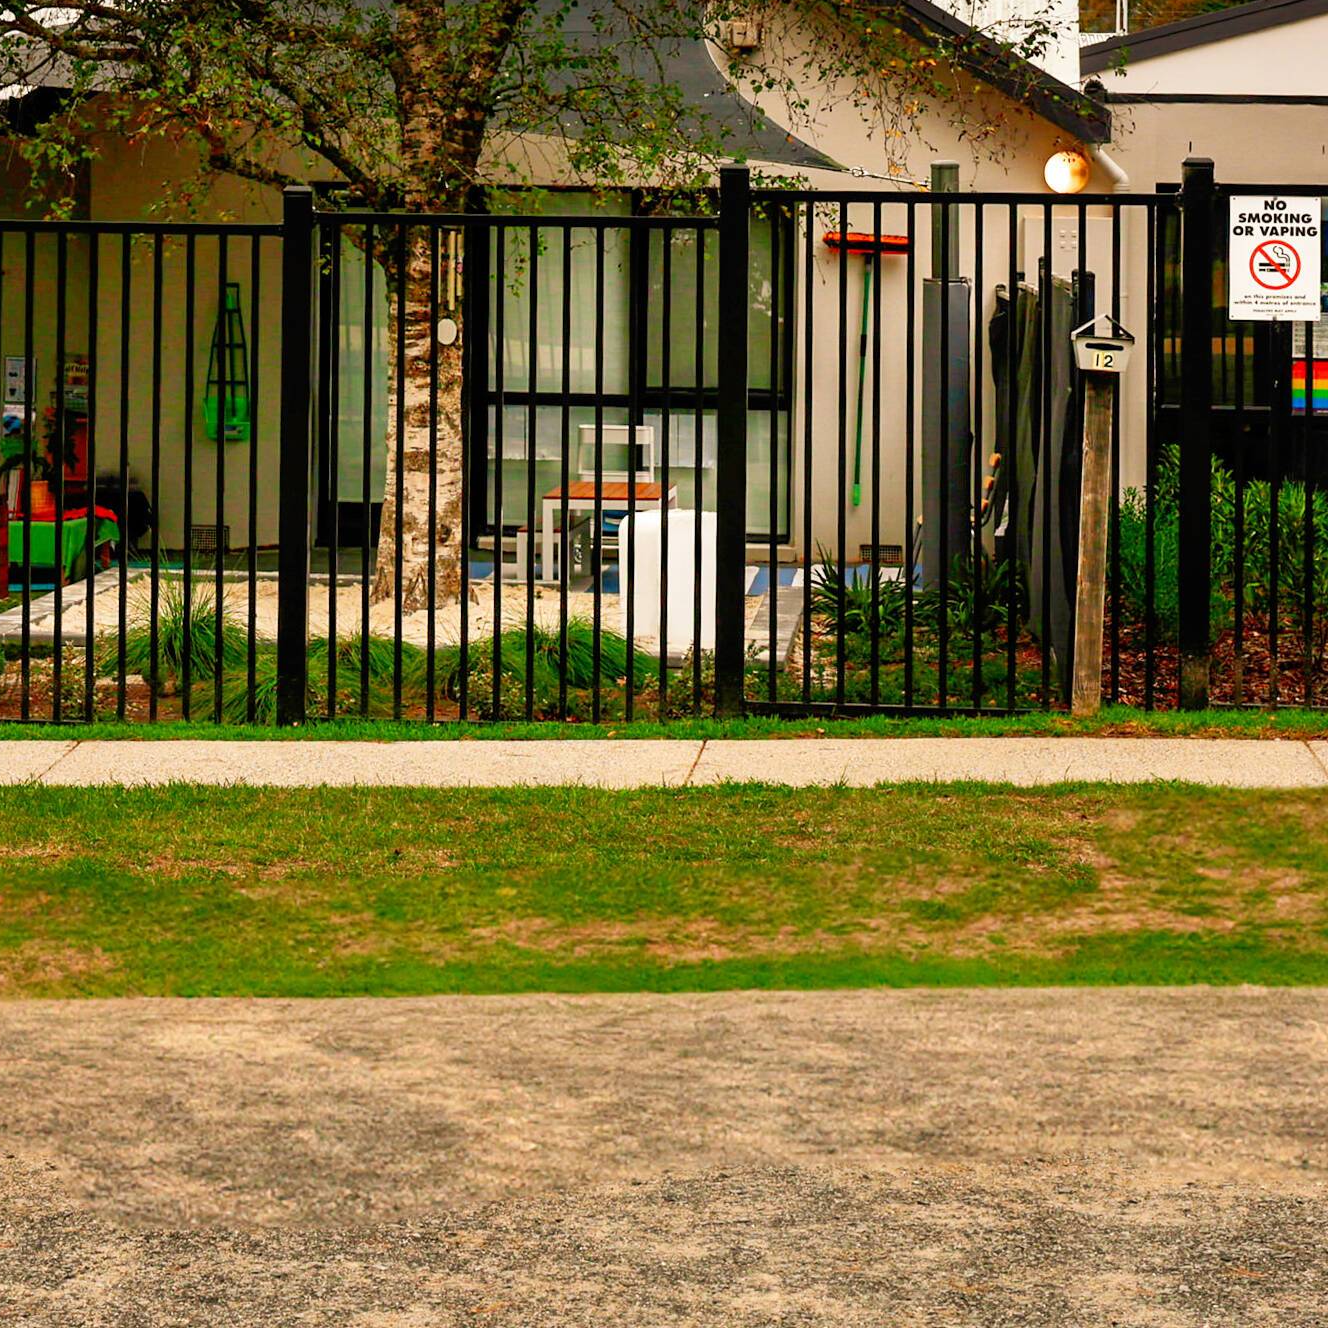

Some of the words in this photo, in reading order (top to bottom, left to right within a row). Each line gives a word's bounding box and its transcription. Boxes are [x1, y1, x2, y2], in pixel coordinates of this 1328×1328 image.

[1264, 200, 1287, 210] NO
[1238, 213, 1313, 223] SMOKING
[1232, 225, 1254, 236] OR
[1260, 226, 1318, 237] VAPING
[1096, 354, 1113, 367] 12
